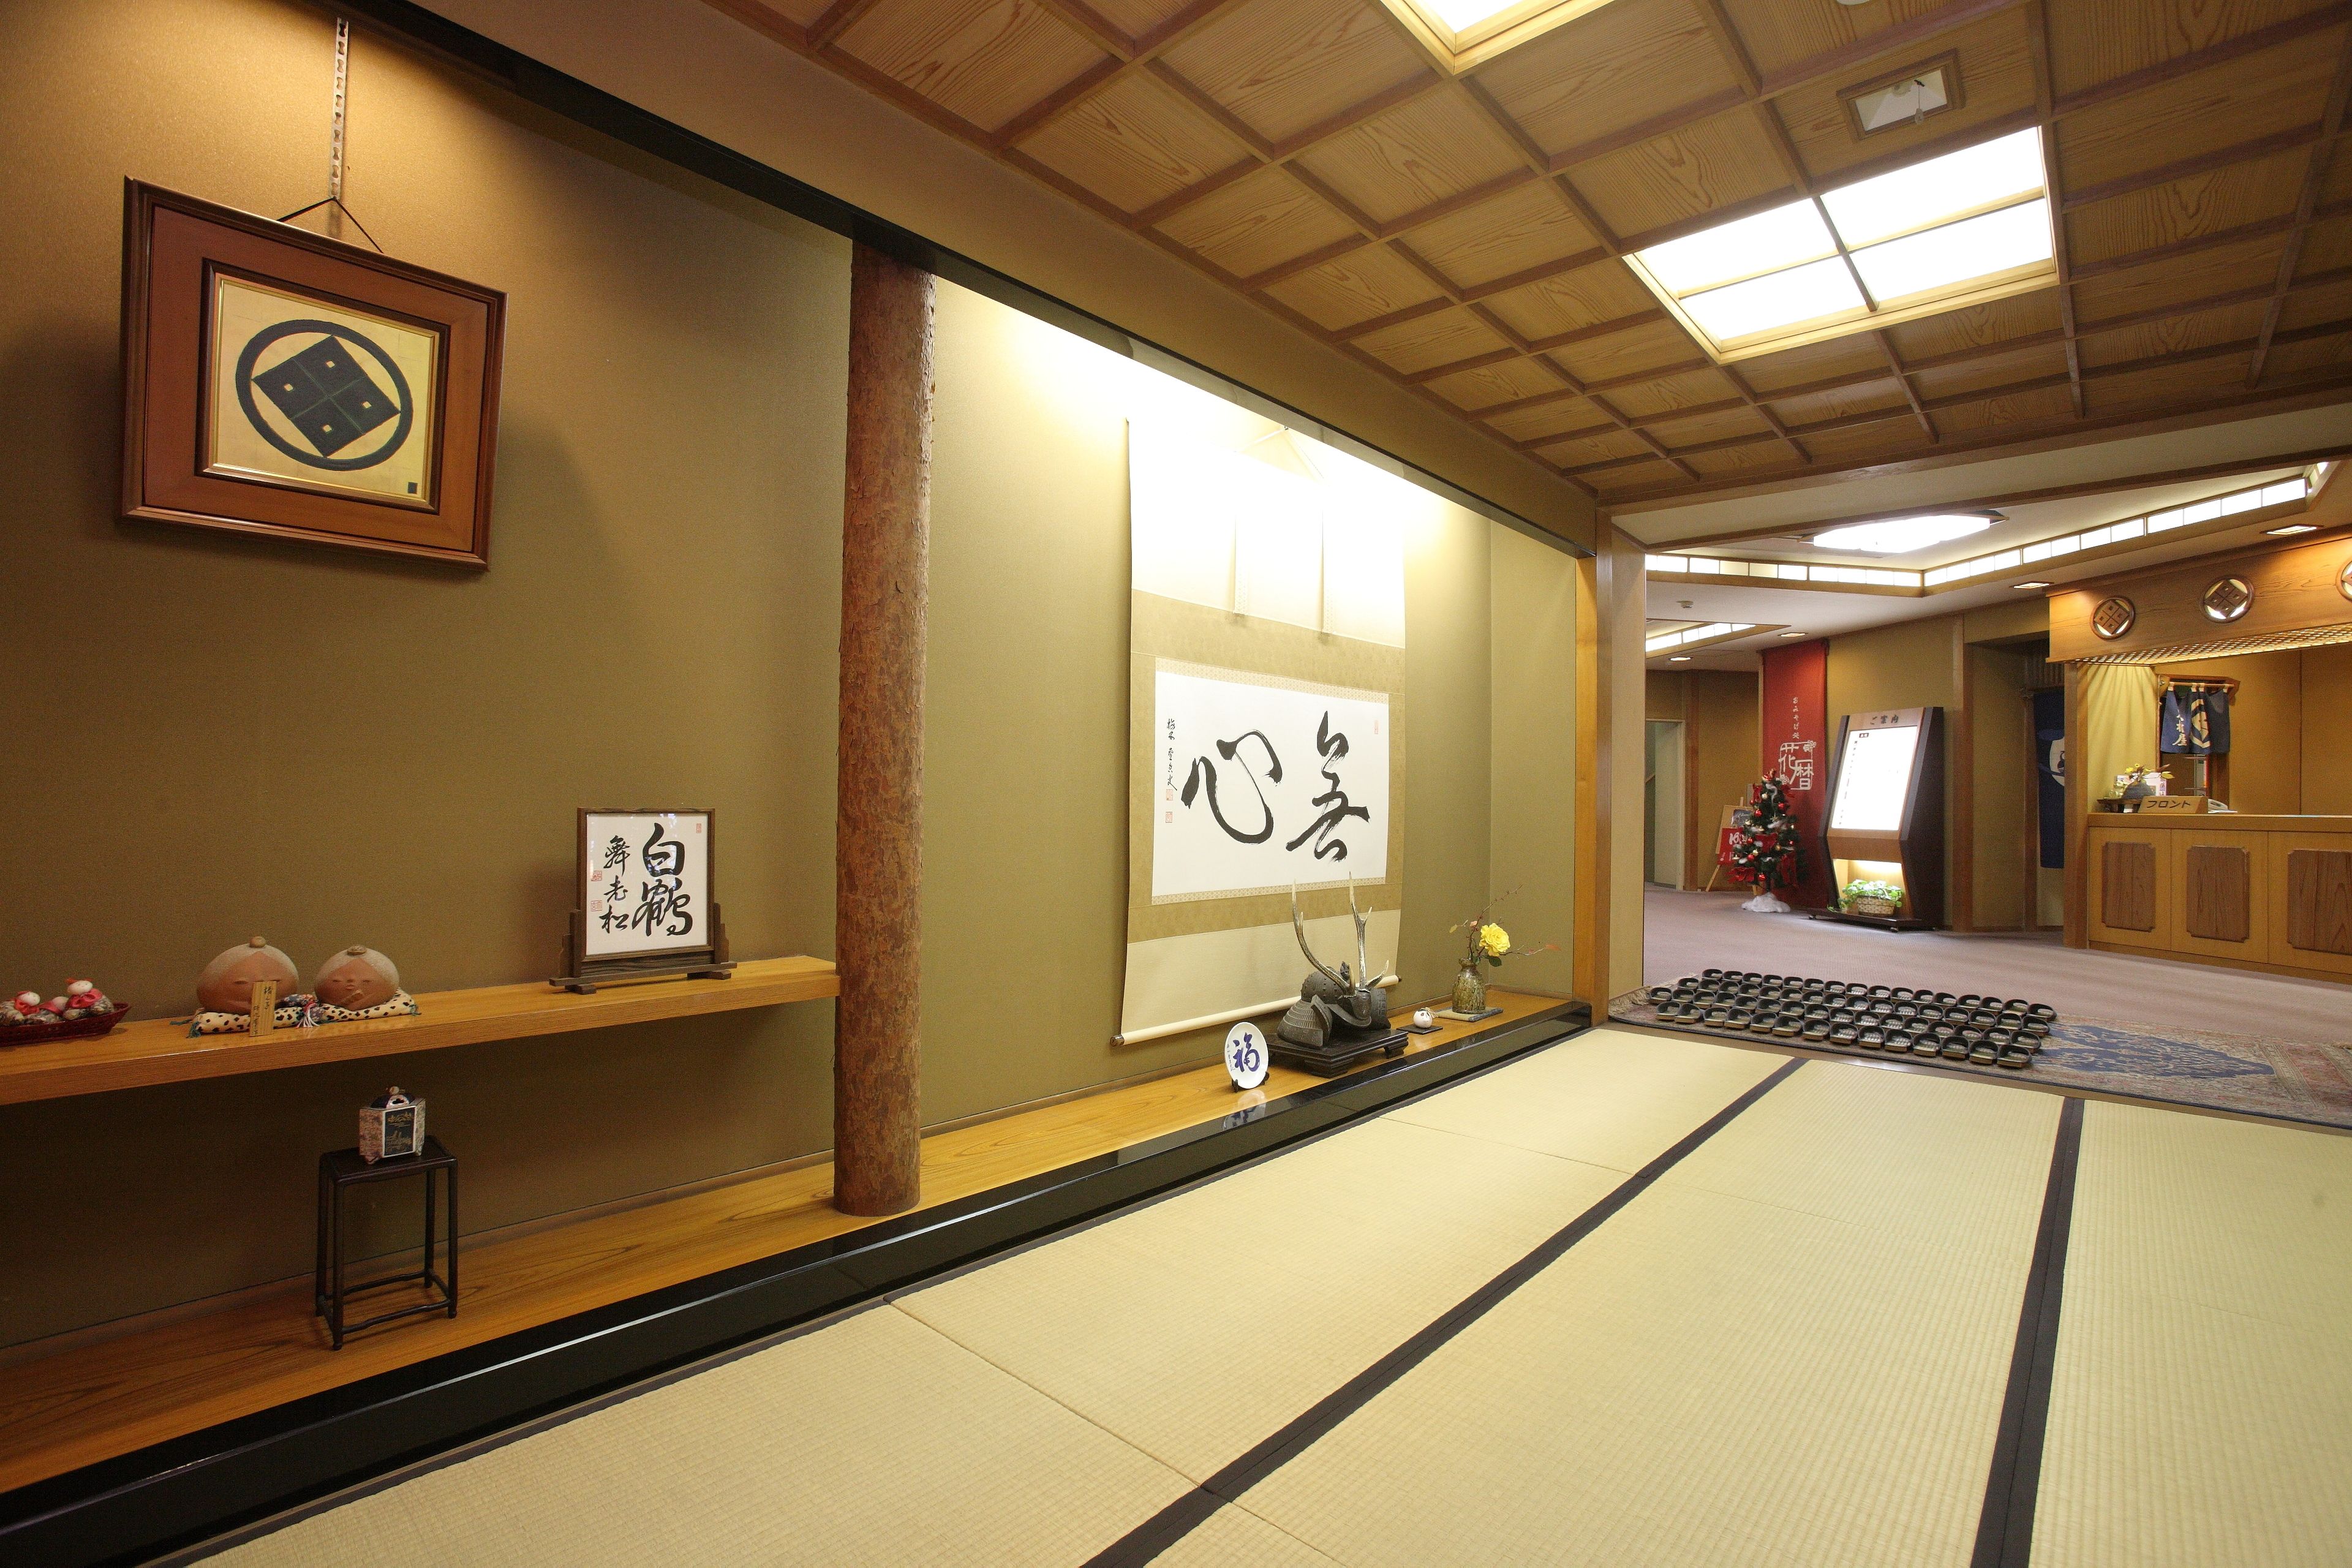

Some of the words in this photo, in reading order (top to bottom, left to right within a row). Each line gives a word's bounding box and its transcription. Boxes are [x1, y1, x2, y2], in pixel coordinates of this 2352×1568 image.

[1870, 714, 1899, 725] ご案内
[2146, 800, 2191, 809] フロント
[1233, 1032, 1260, 1072] 福
